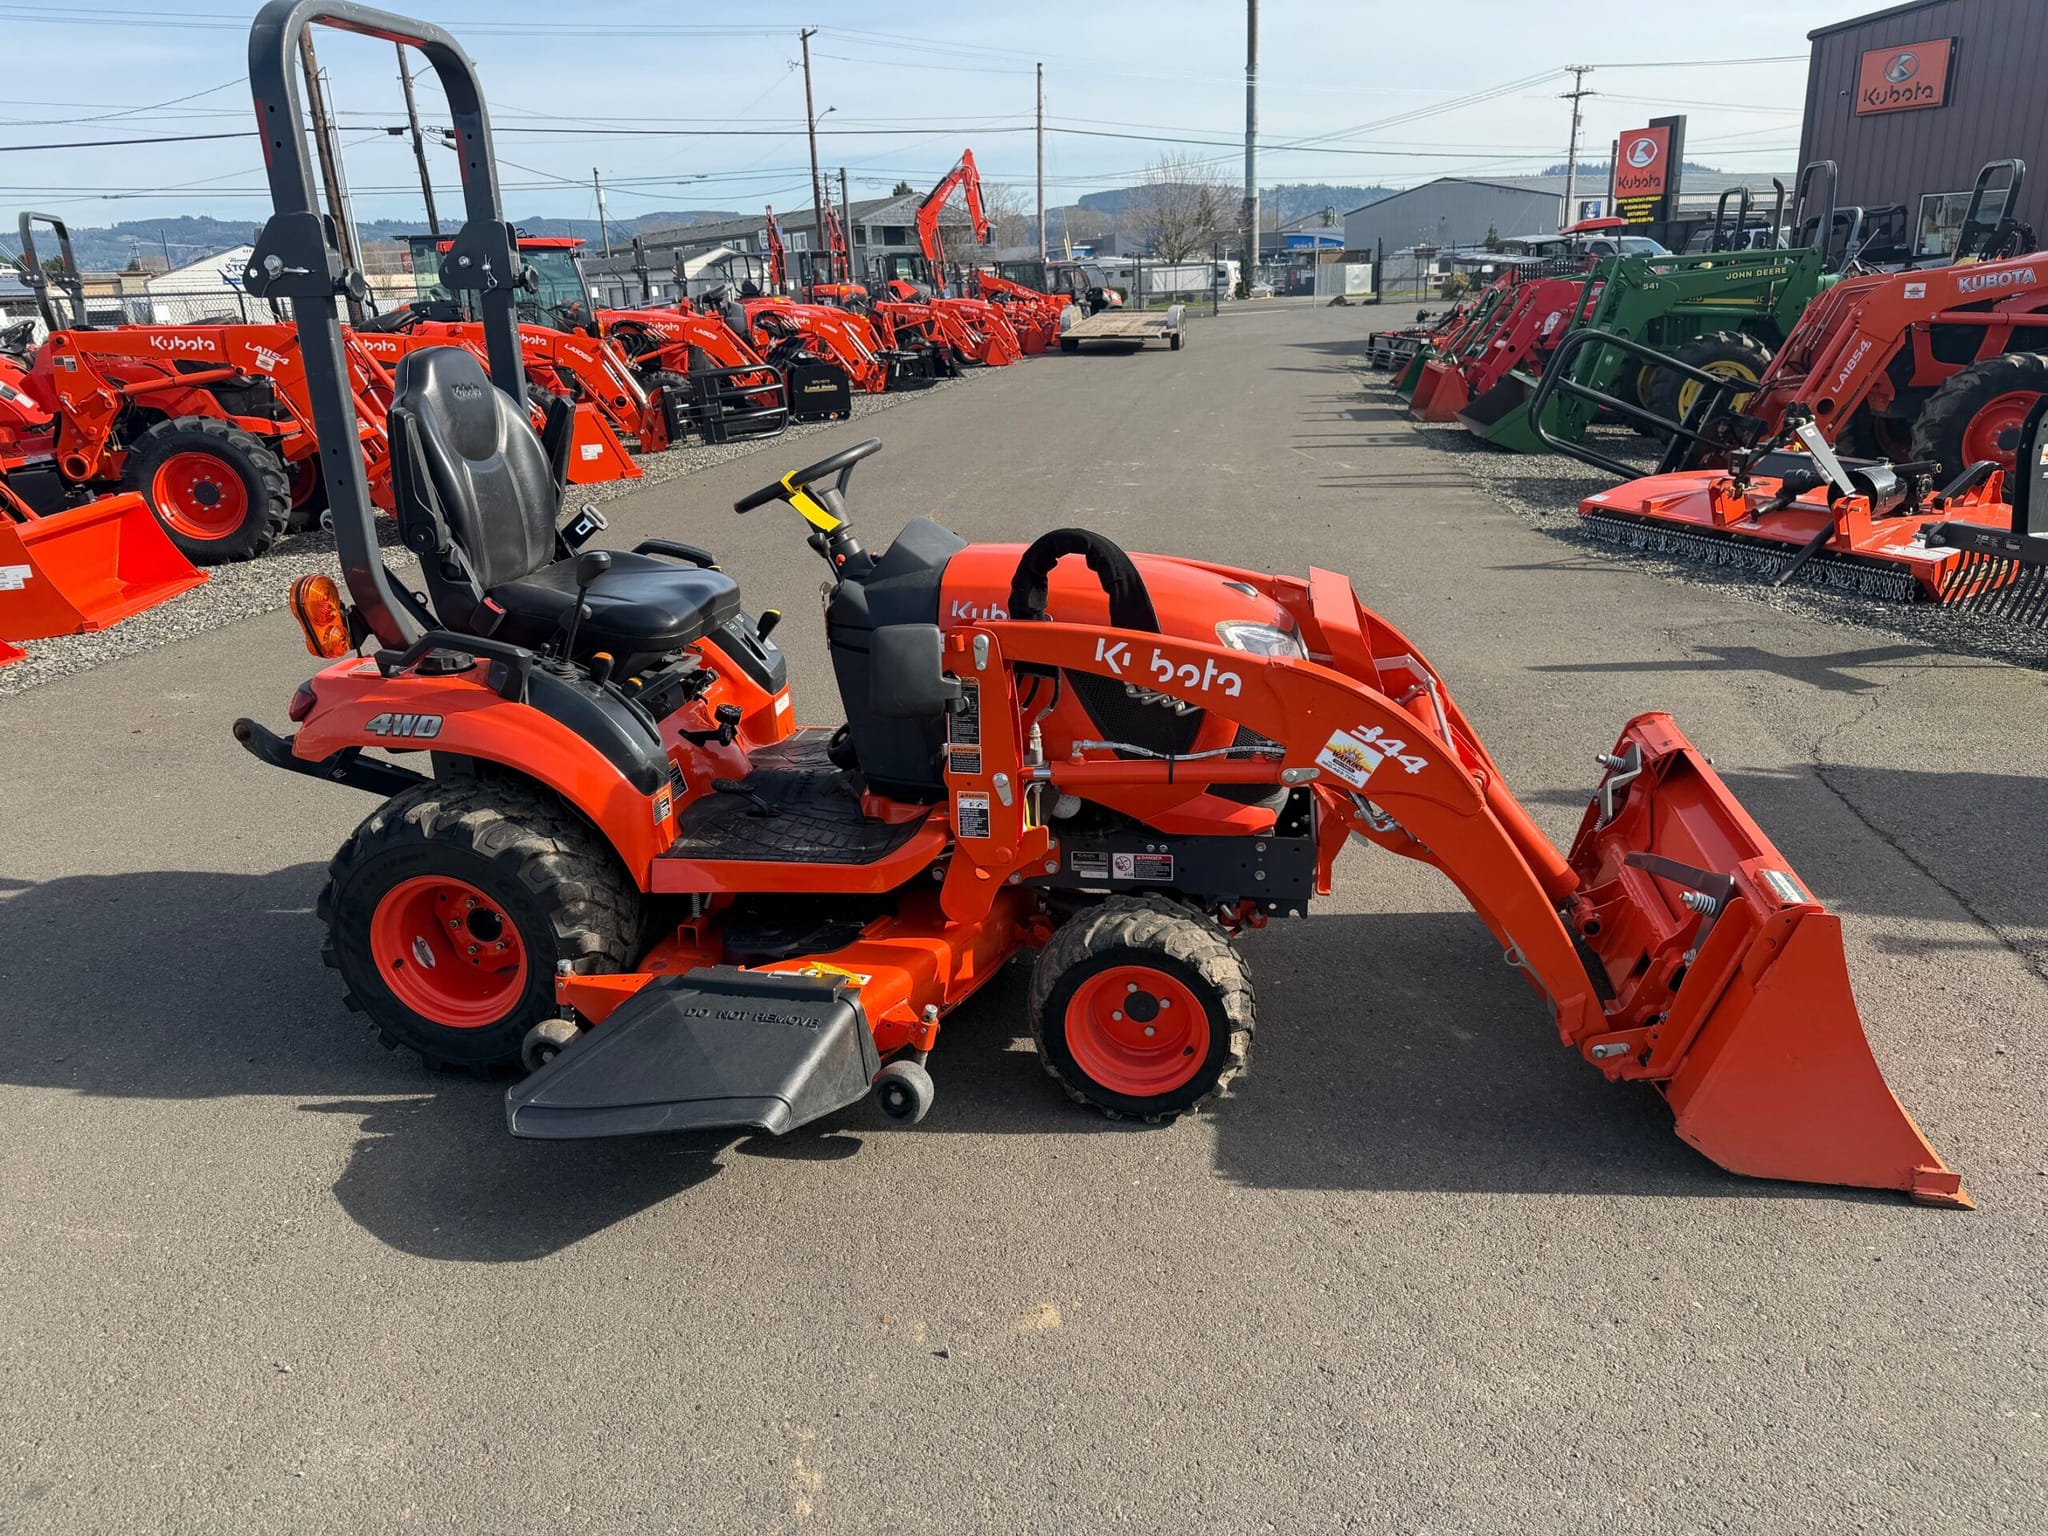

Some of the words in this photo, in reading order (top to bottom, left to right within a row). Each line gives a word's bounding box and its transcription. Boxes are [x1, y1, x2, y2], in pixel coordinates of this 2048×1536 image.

[1863, 81, 1934, 105] Kubota
[1618, 174, 1661, 189] Kubota
[1726, 270, 1752, 280] JOHN
[1756, 266, 1788, 277] DEERE
[1958, 267, 2037, 293] KUBOTA
[1643, 282, 1659, 290] 541
[150, 335, 216, 351] Kubota
[363, 338, 397, 352] bota
[519, 332, 547, 346] bota
[1832, 340, 1872, 393] LA1854
[951, 600, 1008, 620] Kub
[365, 712, 444, 738] 4WD
[1332, 750, 1364, 772] WATKINS
[684, 1008, 710, 1018] DO
[716, 1009, 750, 1021] NOT
[752, 1012, 822, 1031] REMOVE
